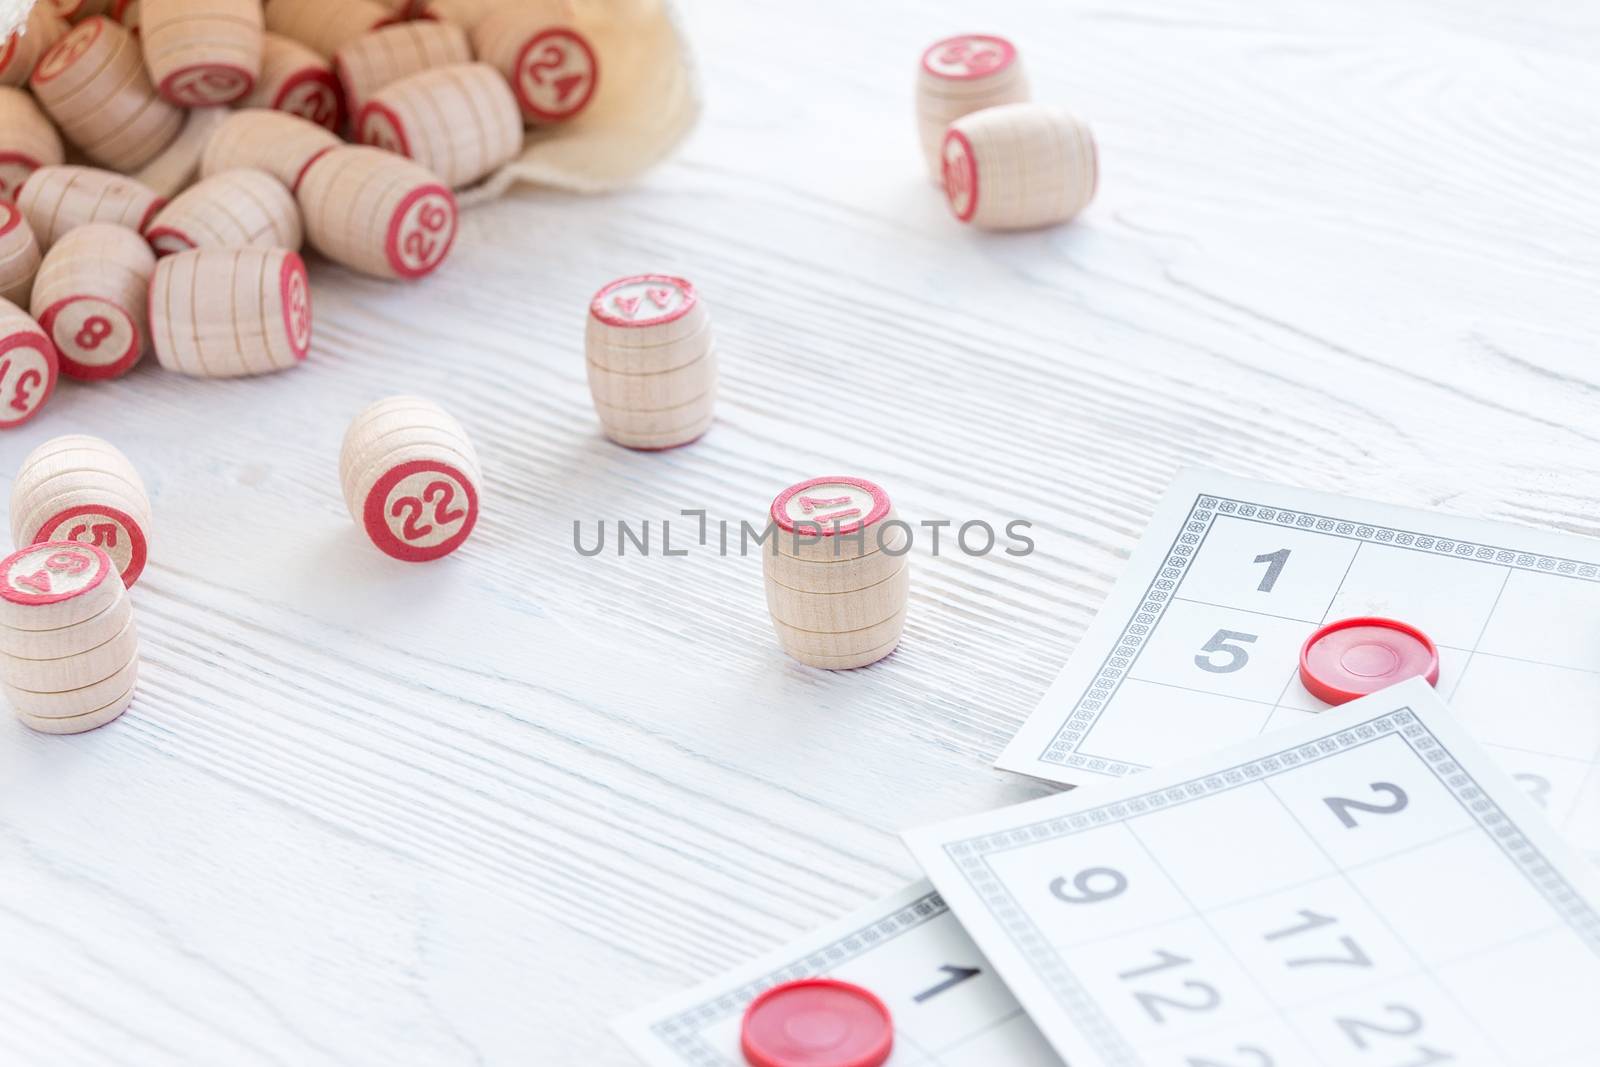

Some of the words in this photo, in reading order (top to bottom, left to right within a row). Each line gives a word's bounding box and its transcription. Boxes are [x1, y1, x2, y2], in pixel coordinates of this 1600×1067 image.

[529, 46, 582, 101] 24
[404, 203, 447, 261] 26
[75, 316, 112, 350] 8
[391, 481, 464, 540] 22
[1252, 548, 1291, 593] 1
[1194, 629, 1258, 673] 5
[1323, 782, 1409, 829] 2
[1049, 867, 1128, 904] 9
[1264, 910, 1374, 968] 17
[911, 964, 982, 1003] 1
[1118, 950, 1221, 1023] 12
